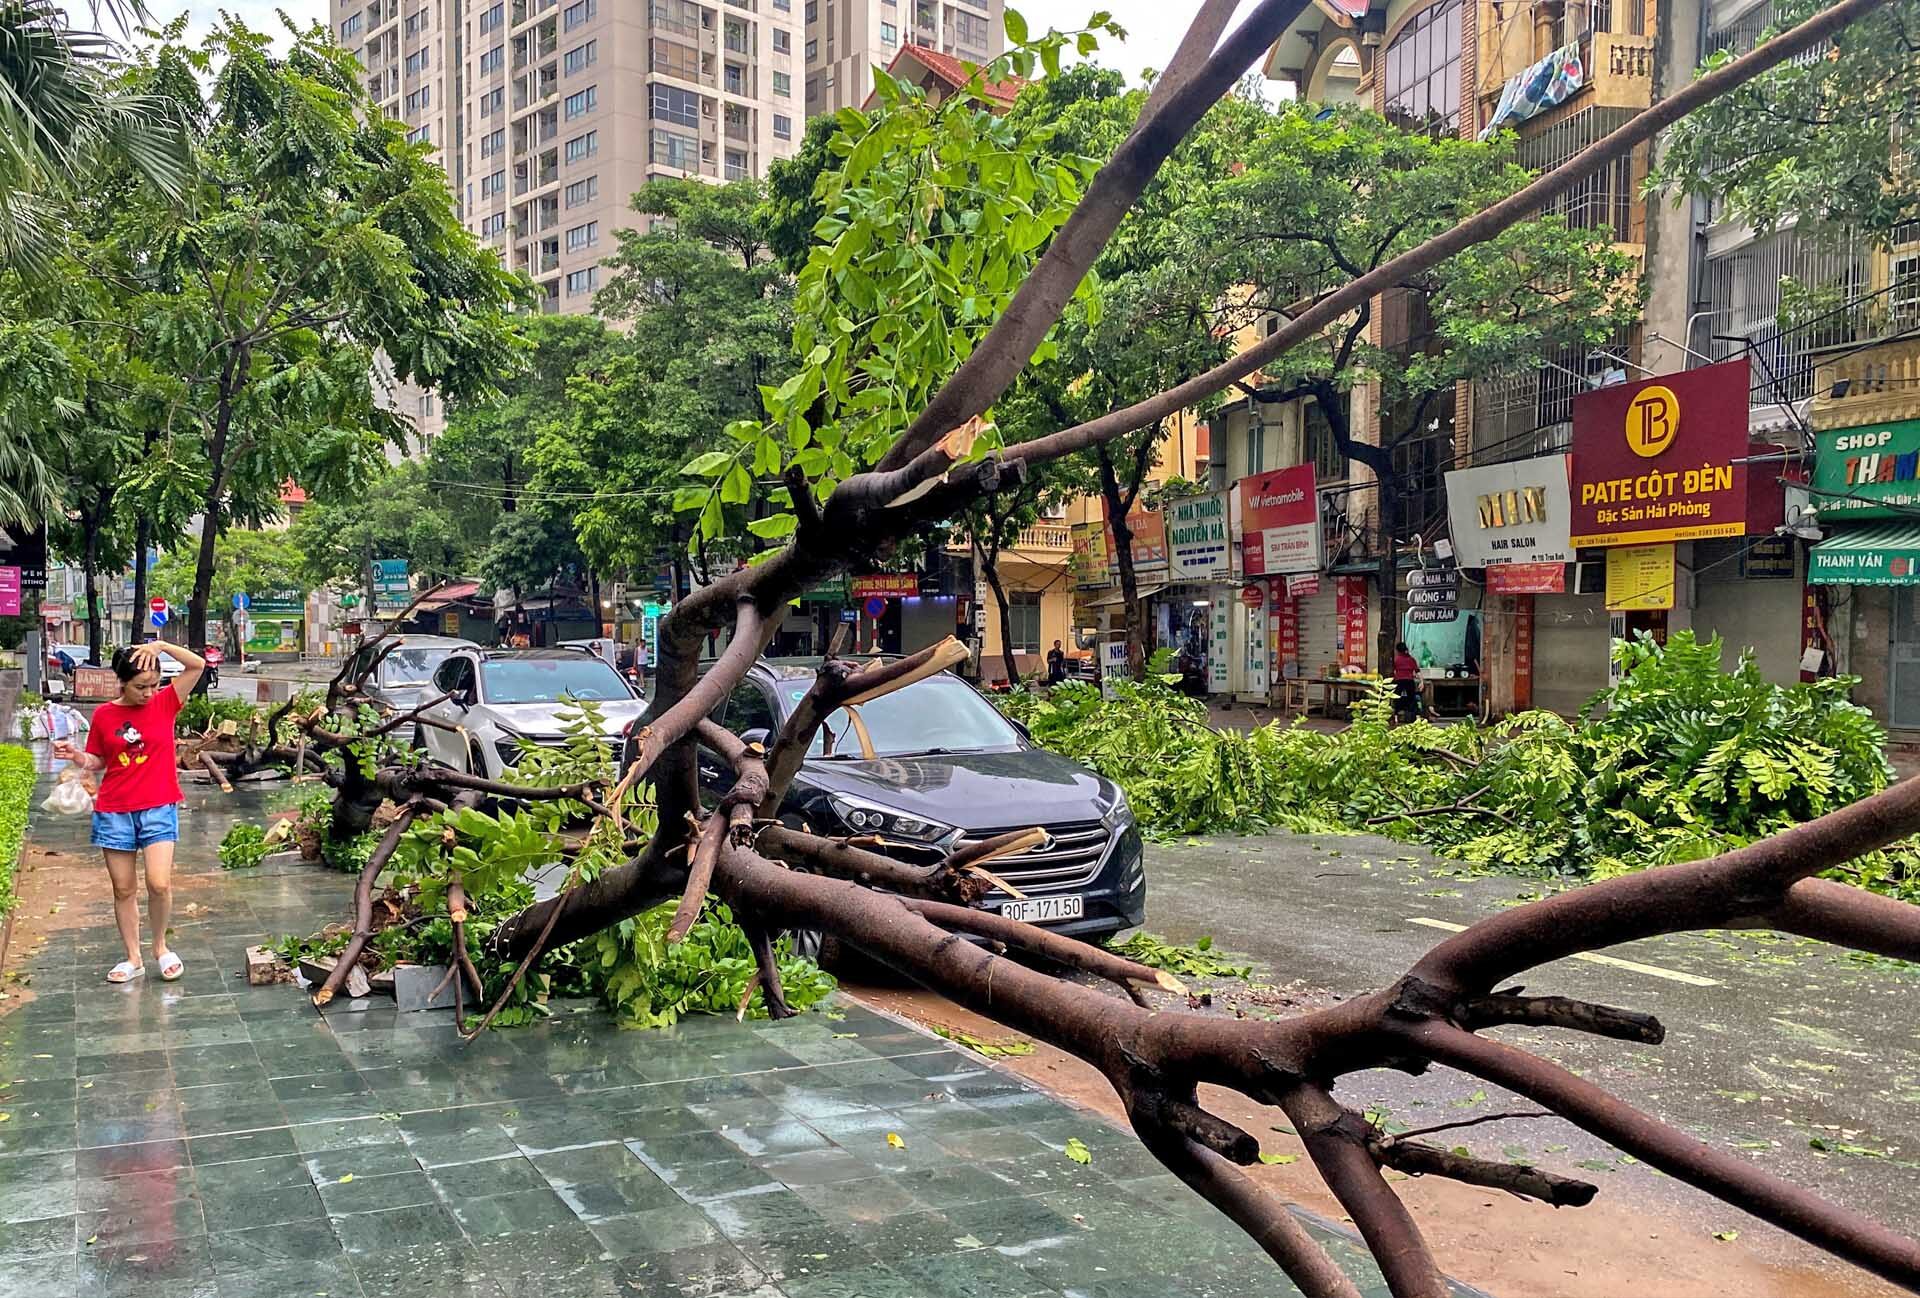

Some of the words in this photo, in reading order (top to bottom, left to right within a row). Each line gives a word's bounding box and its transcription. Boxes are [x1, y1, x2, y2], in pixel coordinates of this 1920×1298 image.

[1836, 431, 1892, 450] SHOP
[1582, 479, 1632, 505] PATE
[1636, 469, 1678, 501] CỘT
[1683, 462, 1733, 494] ĐÈN
[1178, 500, 1194, 520] NHÀ
[1195, 493, 1222, 519] THUỐC
[1261, 488, 1305, 507] vietnamobile
[1476, 485, 1546, 528] MIN
[1597, 509, 1618, 525] Đặc
[1622, 505, 1643, 521] Sản
[1646, 504, 1666, 519] Hải
[1669, 500, 1711, 517] Phòng
[1491, 539, 1508, 550] HAIR
[1511, 537, 1536, 549] SALON
[1817, 555, 1854, 567] THANH
[1858, 552, 1882, 567] VÂN
[1426, 574, 1441, 584] NAM
[1446, 591, 1456, 601] MI
[1414, 610, 1436, 621] PHUN
[1004, 898, 1080, 921] 30F-171.50
